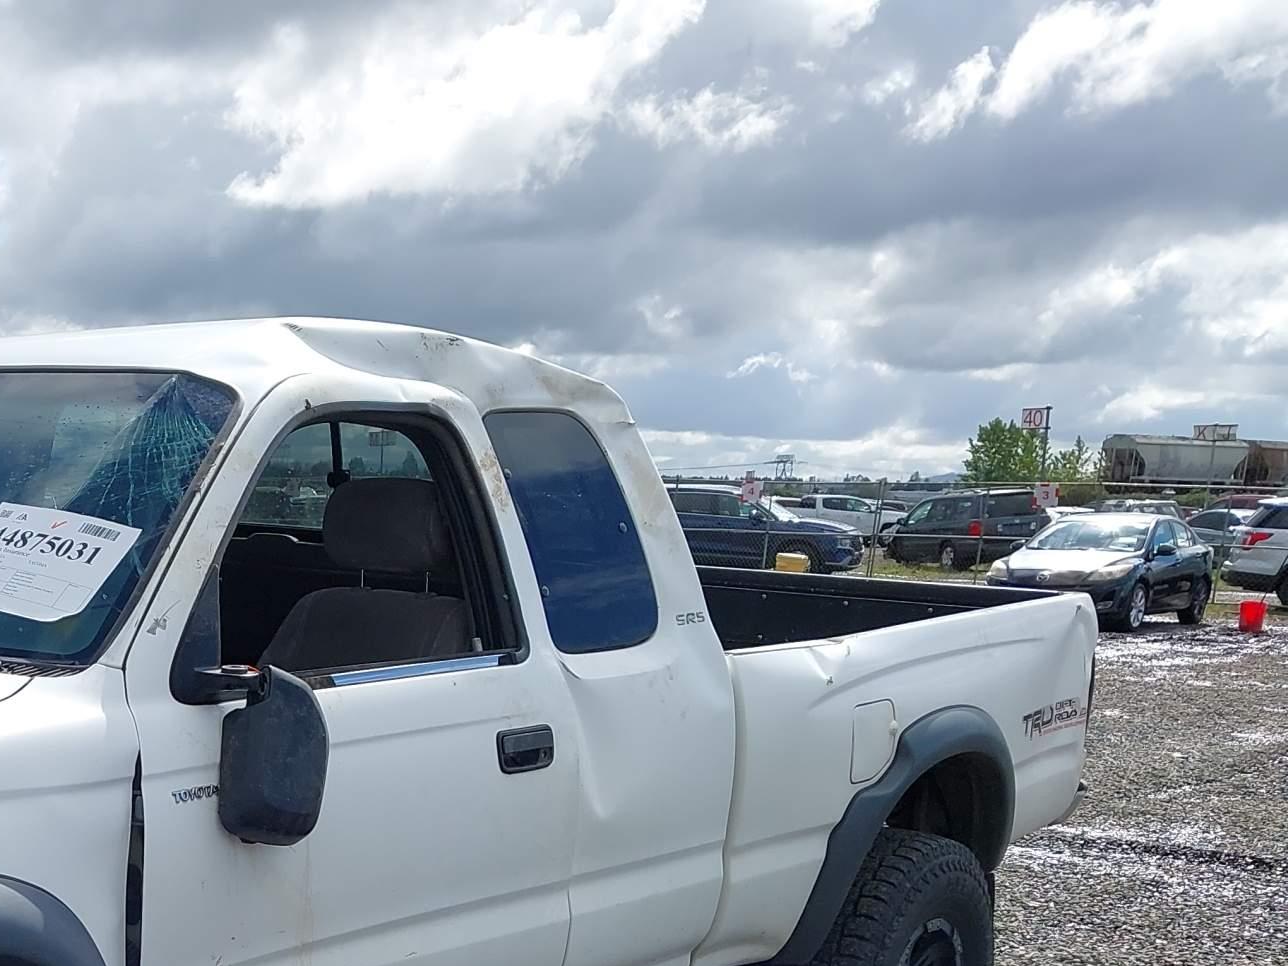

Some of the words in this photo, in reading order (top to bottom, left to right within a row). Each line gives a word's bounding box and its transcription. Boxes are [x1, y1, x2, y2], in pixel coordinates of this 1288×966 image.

[1023, 409, 1043, 427] 40
[1042, 490, 1049, 500] 3
[675, 611, 705, 626] SR5
[1023, 704, 1054, 741] TRD
